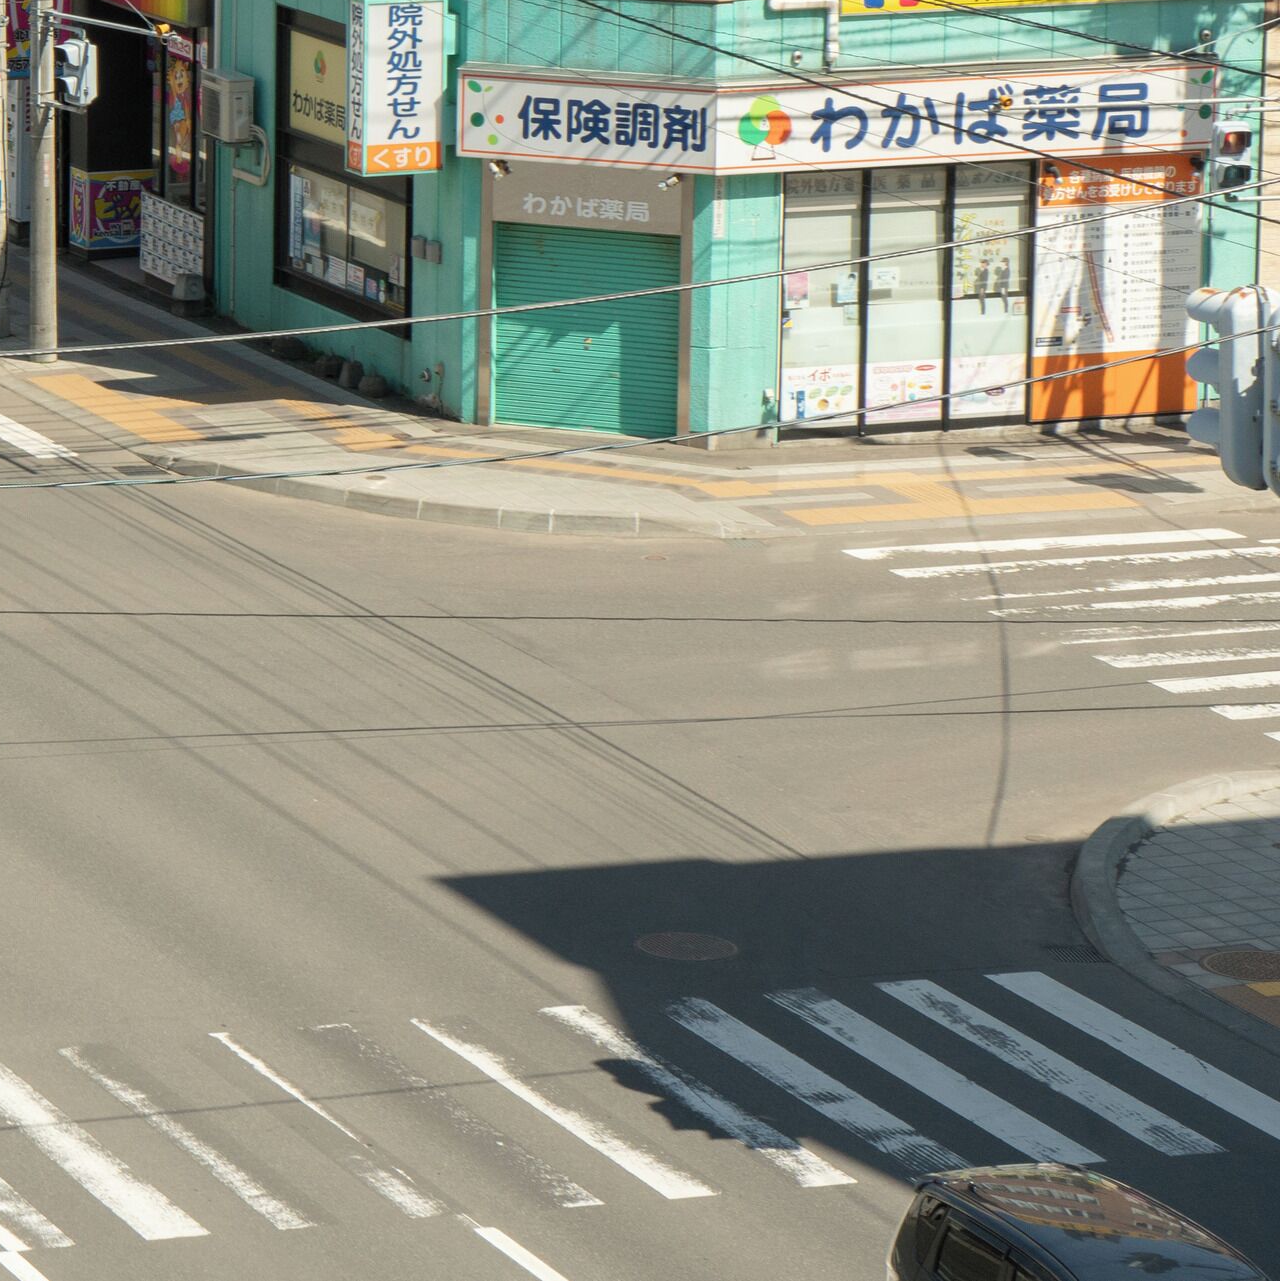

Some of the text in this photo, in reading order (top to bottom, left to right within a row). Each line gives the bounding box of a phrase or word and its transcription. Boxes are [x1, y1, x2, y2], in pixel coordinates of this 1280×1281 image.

[351, 4, 363, 140] 院外処方せん
[387, 4, 423, 141] 院外処方せん
[292, 89, 346, 131] わかば薬局
[518, 95, 708, 153] 保険調剤
[810, 81, 1149, 154] わかば薬局
[372, 146, 432, 168] くすり
[523, 193, 650, 223] わかば薬局
